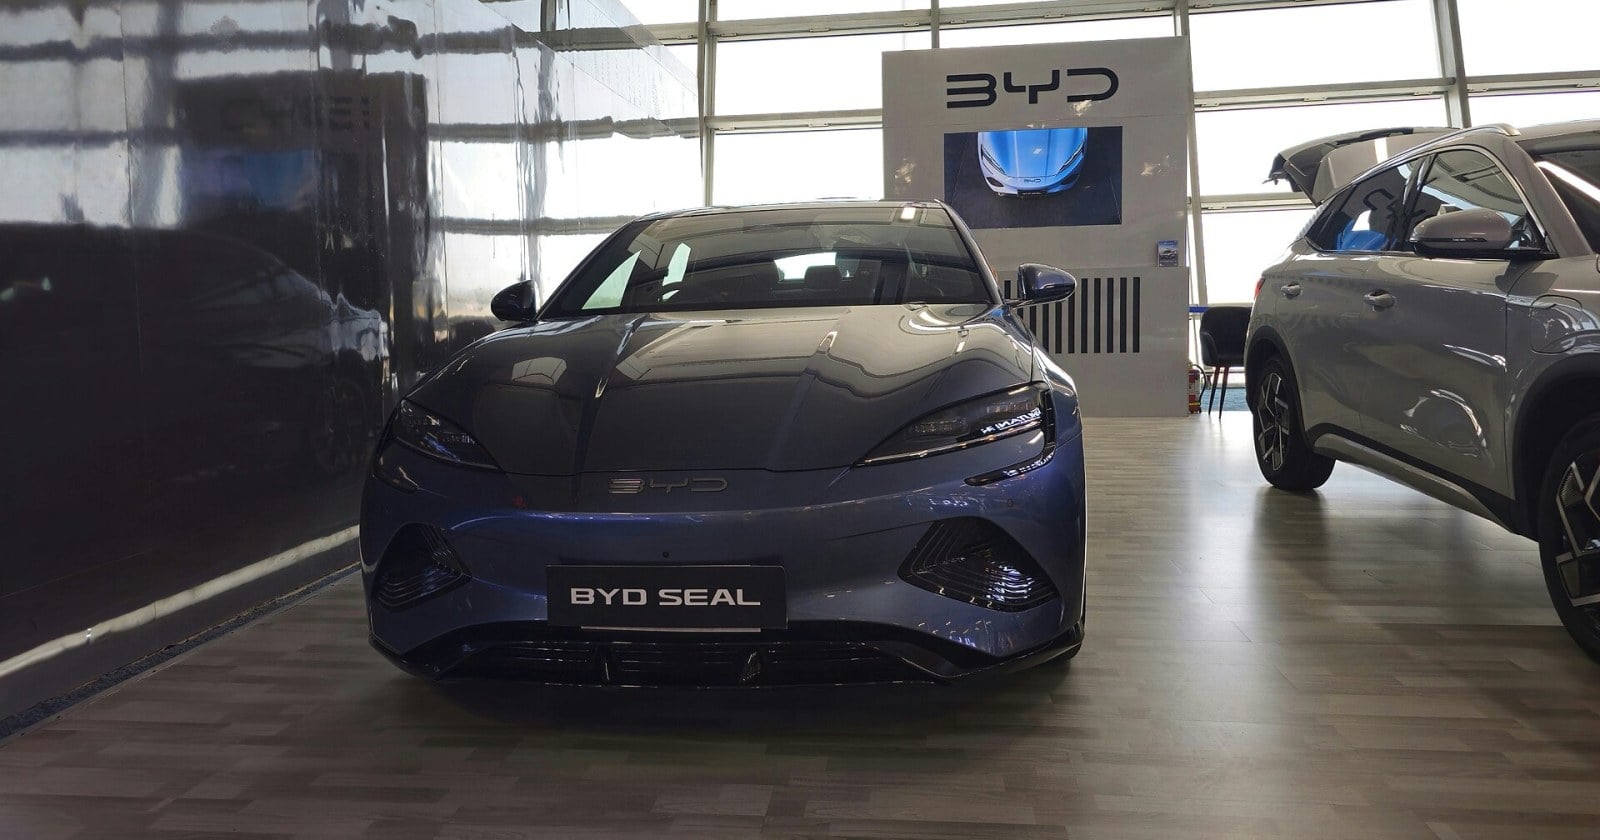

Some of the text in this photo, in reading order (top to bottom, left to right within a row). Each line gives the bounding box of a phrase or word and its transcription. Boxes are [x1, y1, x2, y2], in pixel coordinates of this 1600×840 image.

[946, 67, 1119, 109] BYD
[608, 477, 728, 494] BYD
[570, 587, 761, 606] BYD SEAL
